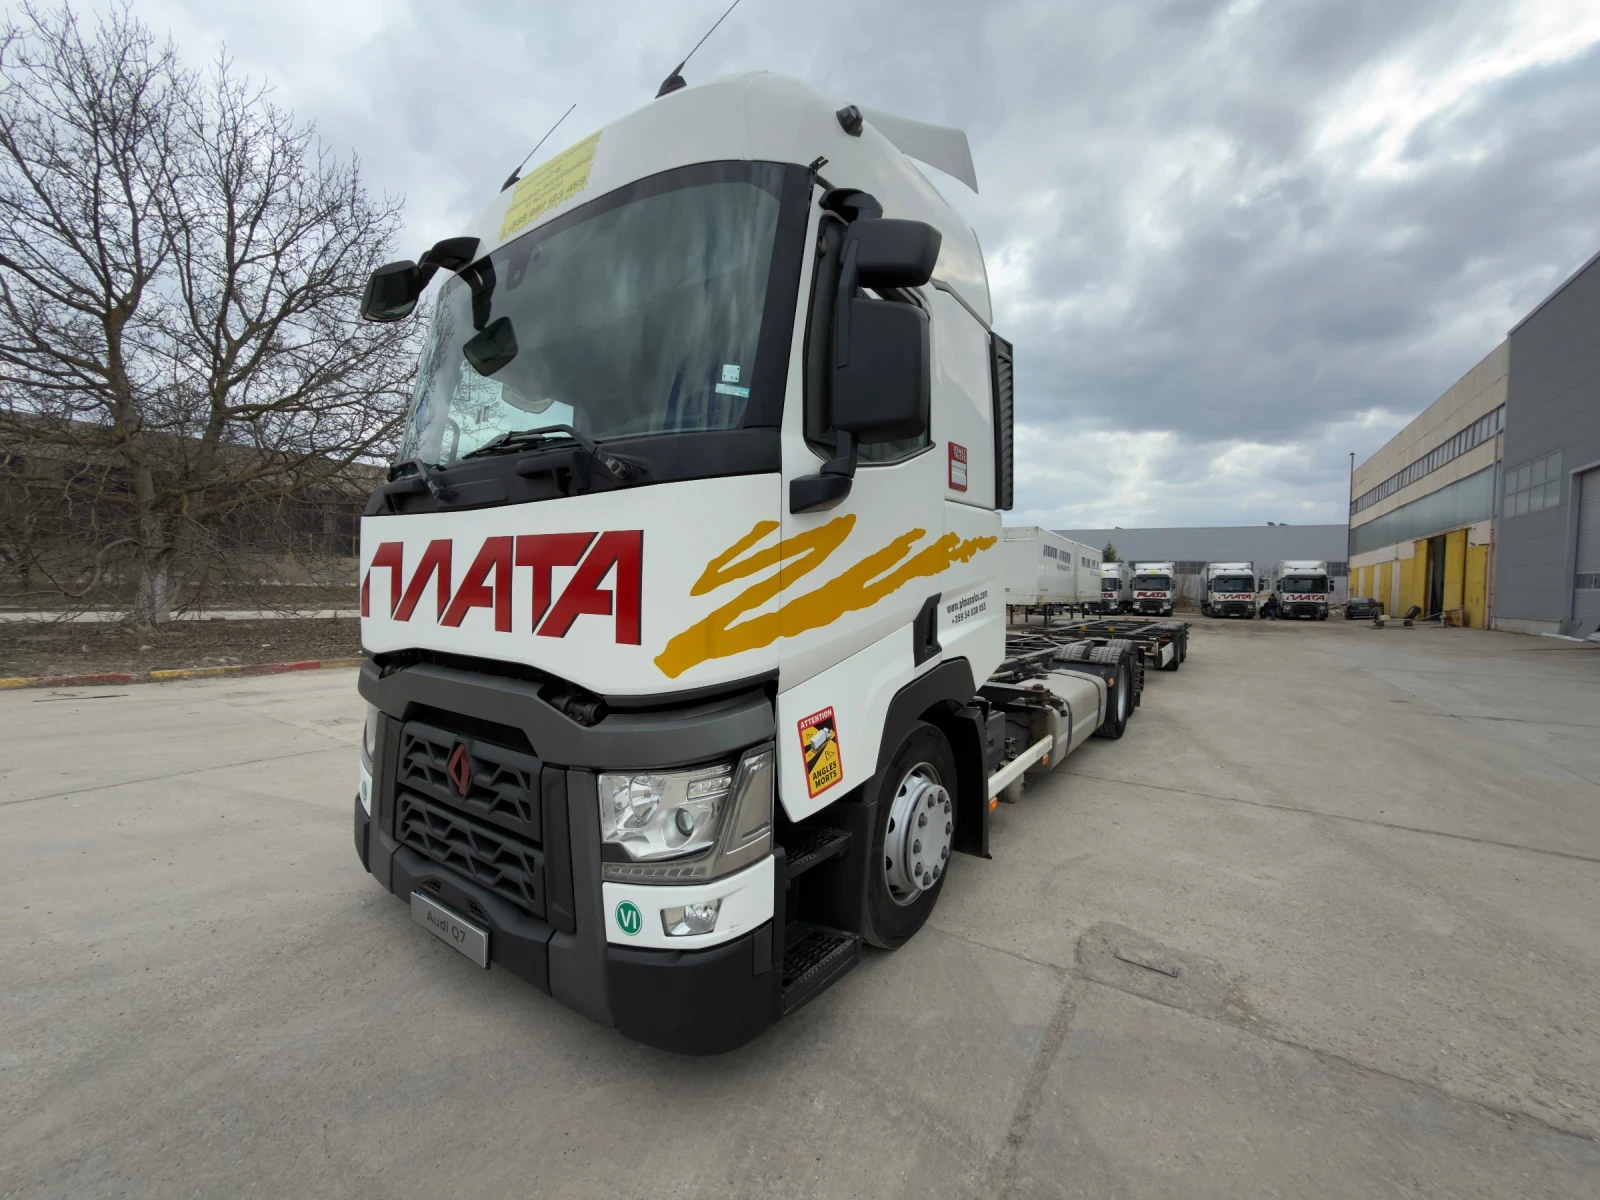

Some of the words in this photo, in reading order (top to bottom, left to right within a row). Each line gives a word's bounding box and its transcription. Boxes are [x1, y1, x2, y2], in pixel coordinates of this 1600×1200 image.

[800, 708, 832, 730] ATTENTION
[812, 760, 837, 781] ANGLES
[814, 769, 837, 789] MORTS
[426, 910, 449, 934] Audi
[451, 925, 466, 943] Q7
[620, 907, 637, 930] VI
